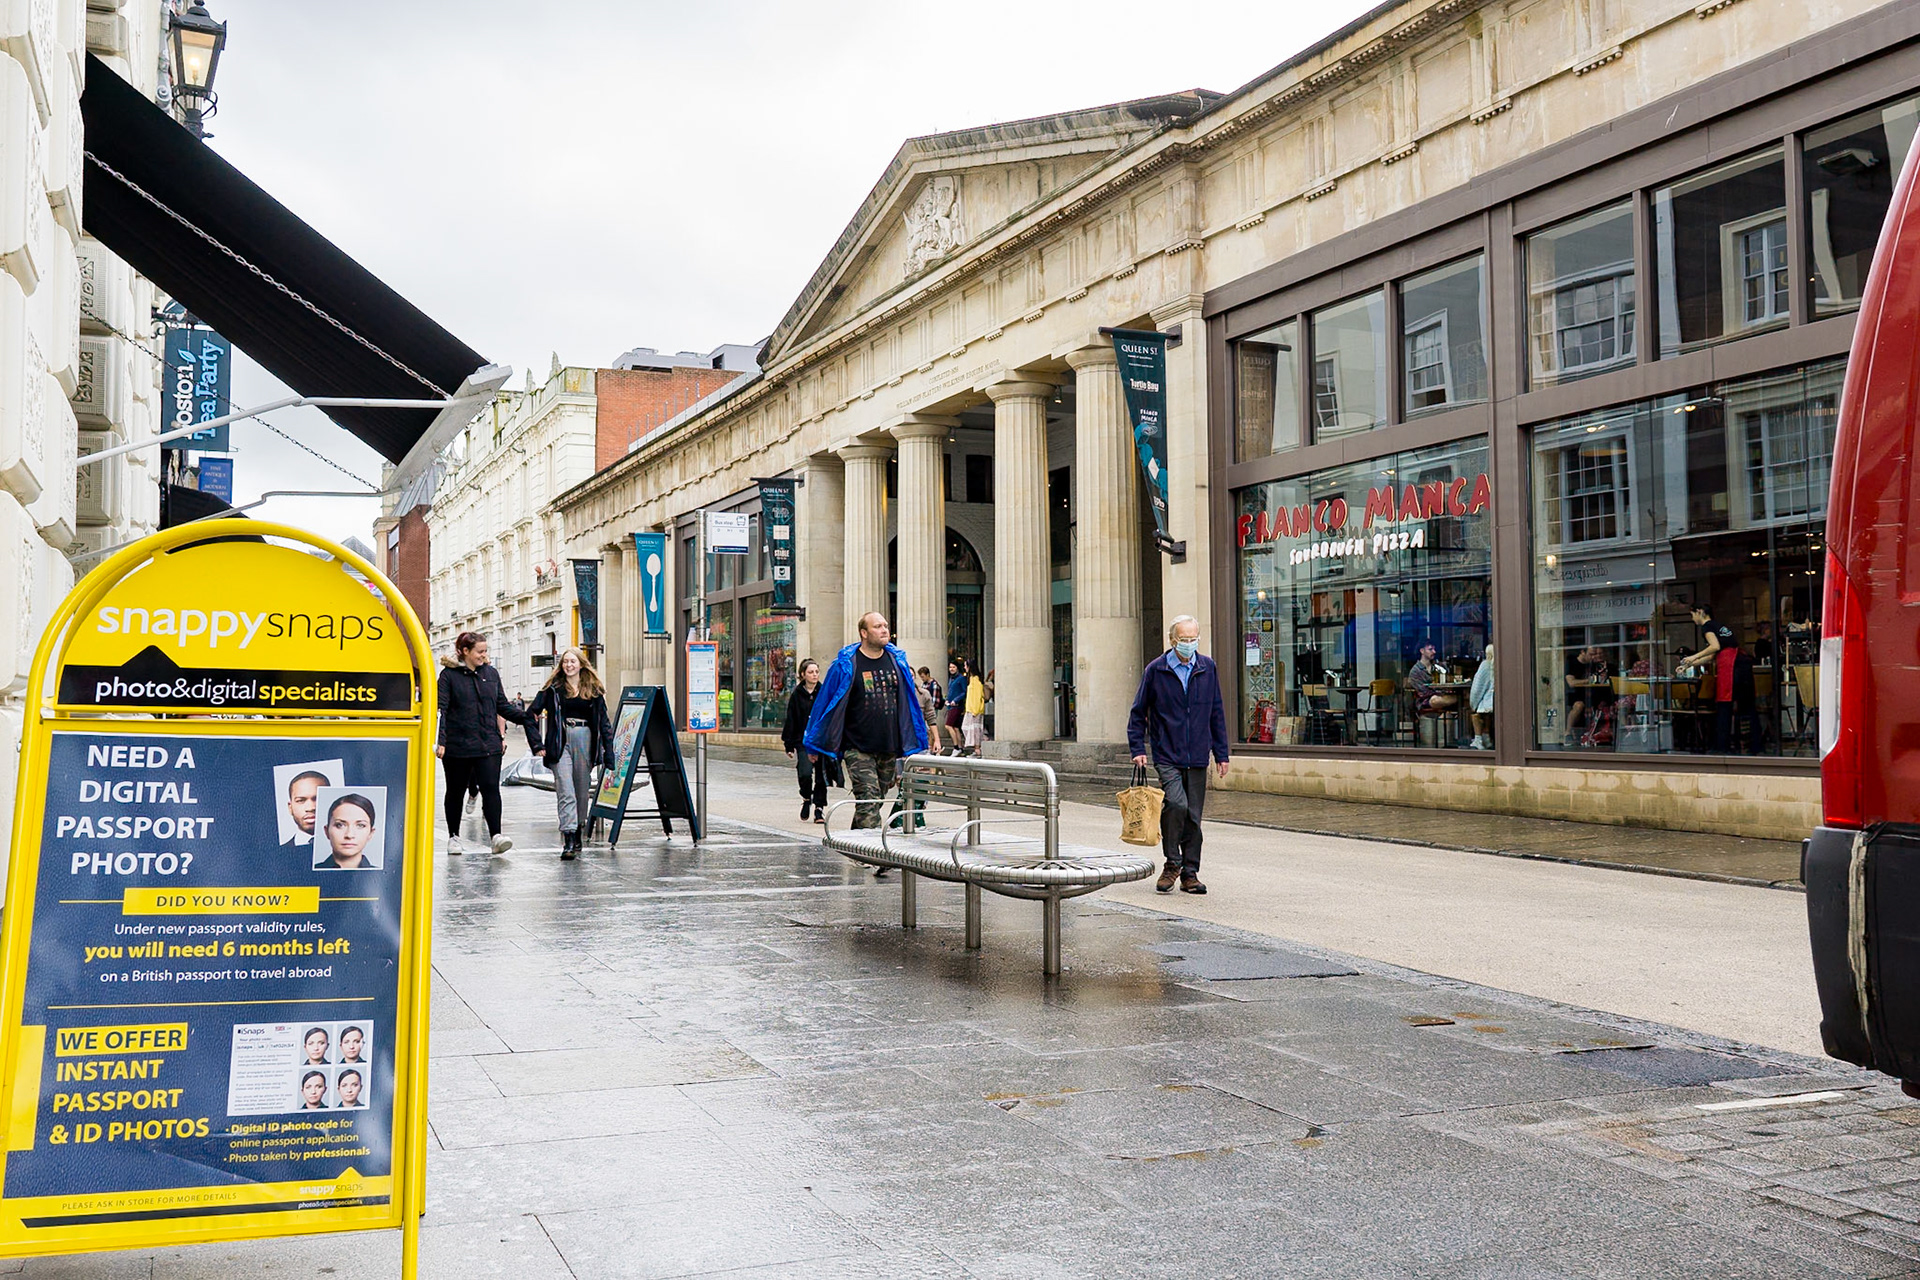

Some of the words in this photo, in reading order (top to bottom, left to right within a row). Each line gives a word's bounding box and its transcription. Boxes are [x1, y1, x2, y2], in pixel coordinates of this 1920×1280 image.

[1121, 344, 1148, 354] QUEEN
[195, 339, 224, 397] Party
[1130, 378, 1146, 389] Turtle
[1147, 381, 1159, 392] Bay
[193, 400, 216, 440] Tea
[1237, 498, 1347, 547] FRANCO
[1363, 473, 1490, 528] MANCA
[1290, 538, 1364, 565] SOURDOUGH
[1373, 529, 1424, 554] PIZZA
[97, 606, 383, 650] snappysnaps
[96, 677, 256, 705] photo&digital
[260, 682, 377, 705] specialists
[87, 745, 168, 768] NEED
[175, 747, 195, 769] A
[80, 781, 197, 804] DIGITAL
[56, 816, 214, 839] PASSPORT
[71, 852, 193, 875] PHOTO?
[156, 895, 186, 907] DID
[194, 895, 225, 907] YOU
[232, 894, 290, 906] KNOW?
[115, 922, 154, 935] Under
[157, 924, 185, 934] new
[188, 922, 243, 937] passport
[246, 921, 291, 936] validity
[294, 922, 326, 934] rules,
[85, 943, 124, 963] you
[128, 942, 164, 958] will
[168, 940, 218, 957] need
[223, 941, 235, 957] 6
[240, 939, 313, 956] months
[317, 939, 350, 954] left
[100, 972, 118, 982] on
[121, 973, 129, 982] a
[132, 969, 172, 982] British
[176, 969, 231, 984] passport
[234, 969, 248, 980] to
[250, 967, 285, 979] travel
[289, 966, 332, 978] abroad
[61, 1032, 98, 1050] WE
[105, 1030, 182, 1049] OFFER
[56, 1060, 164, 1082] INSTANT
[53, 1089, 183, 1113] PASSPORT
[49, 1125, 68, 1145] &
[75, 1123, 101, 1142] ID
[108, 1118, 210, 1140] PHOTOS
[231, 1123, 266, 1135] Digital
[268, 1122, 280, 1132] ID
[281, 1121, 312, 1133] photo
[314, 1120, 338, 1129] code
[340, 1119, 353, 1128] for
[230, 1137, 260, 1148] online
[263, 1136, 304, 1148] passport
[306, 1134, 358, 1145] application
[229, 1152, 258, 1162] Photo
[261, 1152, 287, 1161] taken
[290, 1150, 301, 1161] by
[303, 1147, 370, 1160] professionals
[300, 1183, 363, 1196] snappysnaps
[62, 1201, 93, 1210] PLEASE
[96, 1200, 112, 1209] ASK
[115, 1199, 124, 1207] IN
[127, 1198, 154, 1207] STORE
[158, 1197, 174, 1205] FOR
[177, 1196, 200, 1204] MORE
[204, 1193, 237, 1203] DETAILS
